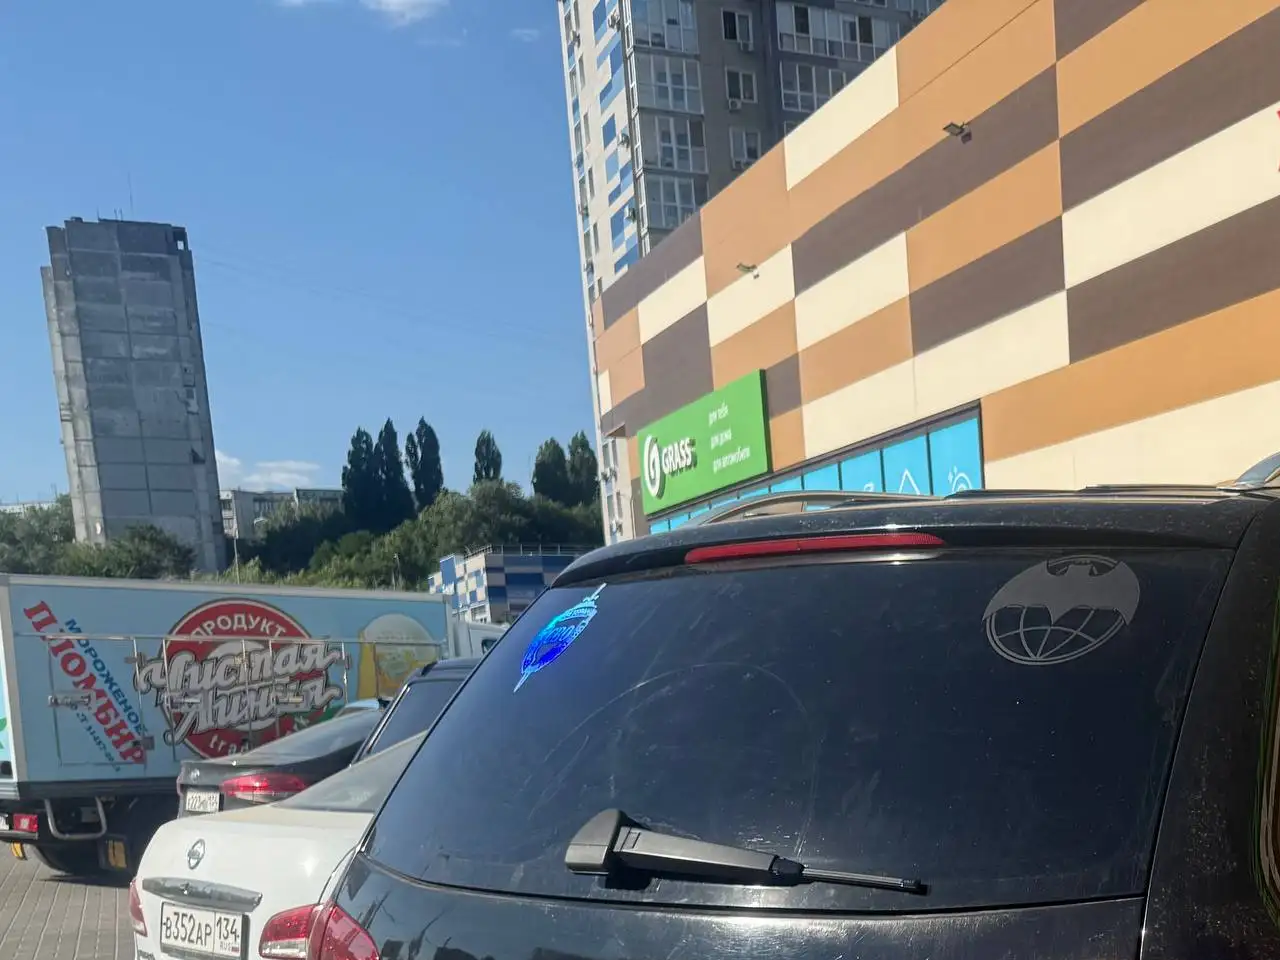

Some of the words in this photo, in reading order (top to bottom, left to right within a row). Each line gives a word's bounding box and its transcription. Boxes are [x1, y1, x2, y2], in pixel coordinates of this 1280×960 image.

[662, 437, 692, 475] GRASS
[190, 613, 288, 644] ПРОДУКТ
[65, 618, 148, 735] МОРОЖЕНОЕ
[164, 911, 212, 947] В352АР
[216, 916, 238, 942] 134
